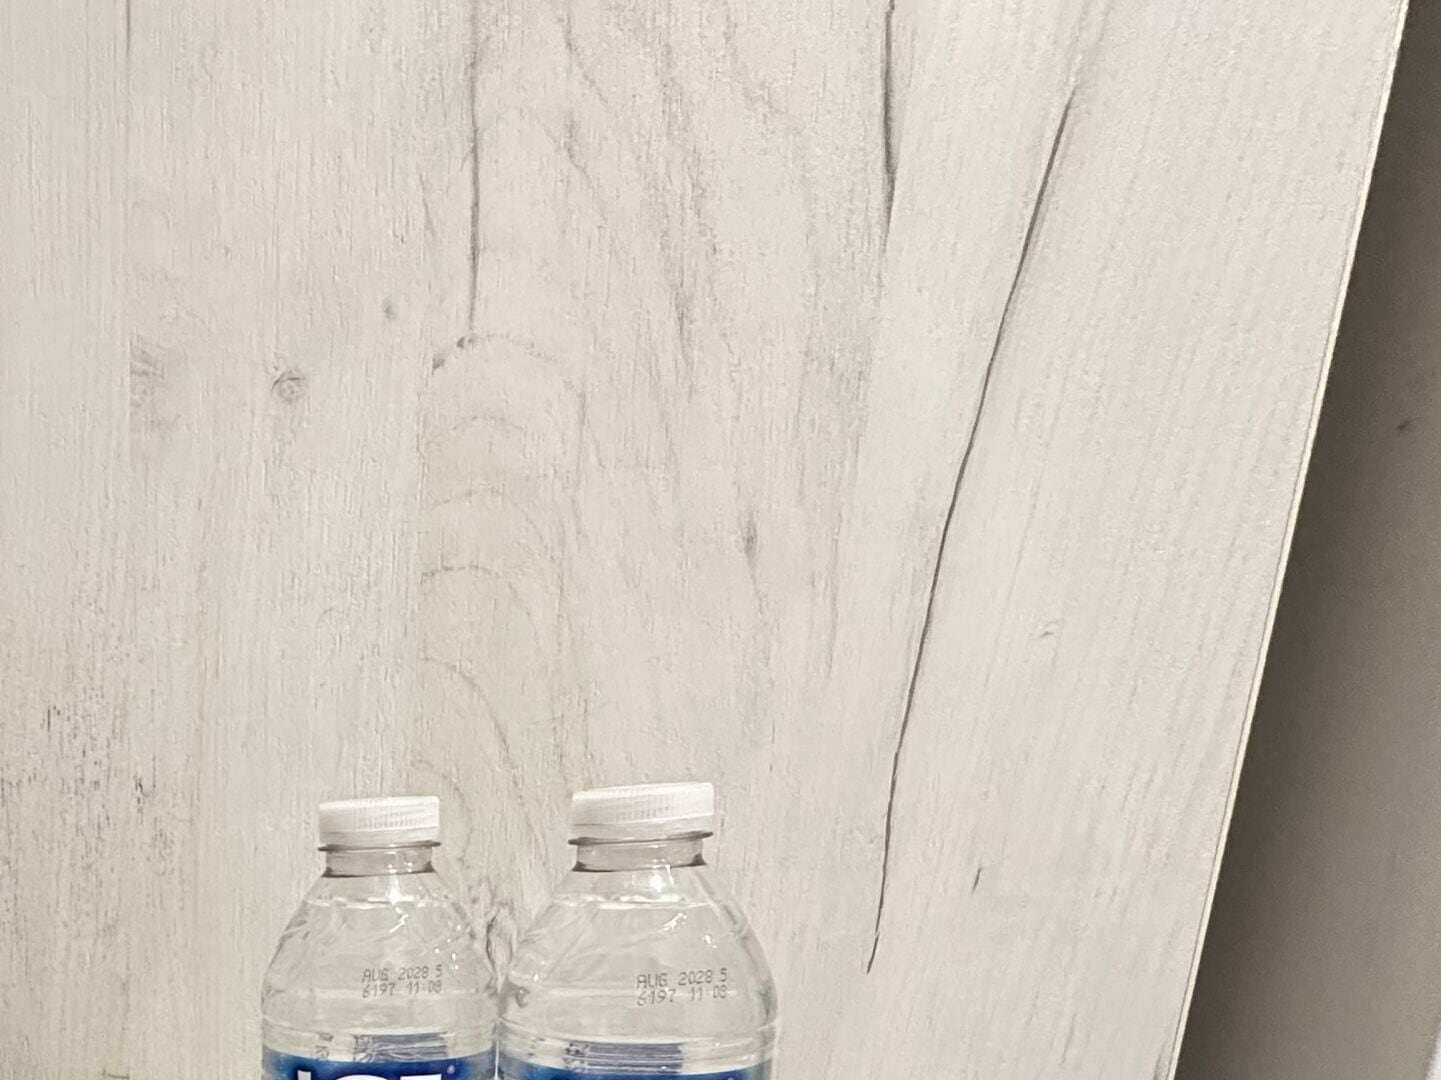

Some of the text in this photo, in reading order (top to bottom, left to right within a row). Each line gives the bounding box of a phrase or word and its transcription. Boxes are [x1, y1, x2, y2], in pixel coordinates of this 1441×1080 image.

[362, 968, 388, 983] AUG
[398, 966, 429, 980] 2028
[637, 974, 667, 989] AUG
[678, 970, 713, 985] 2028
